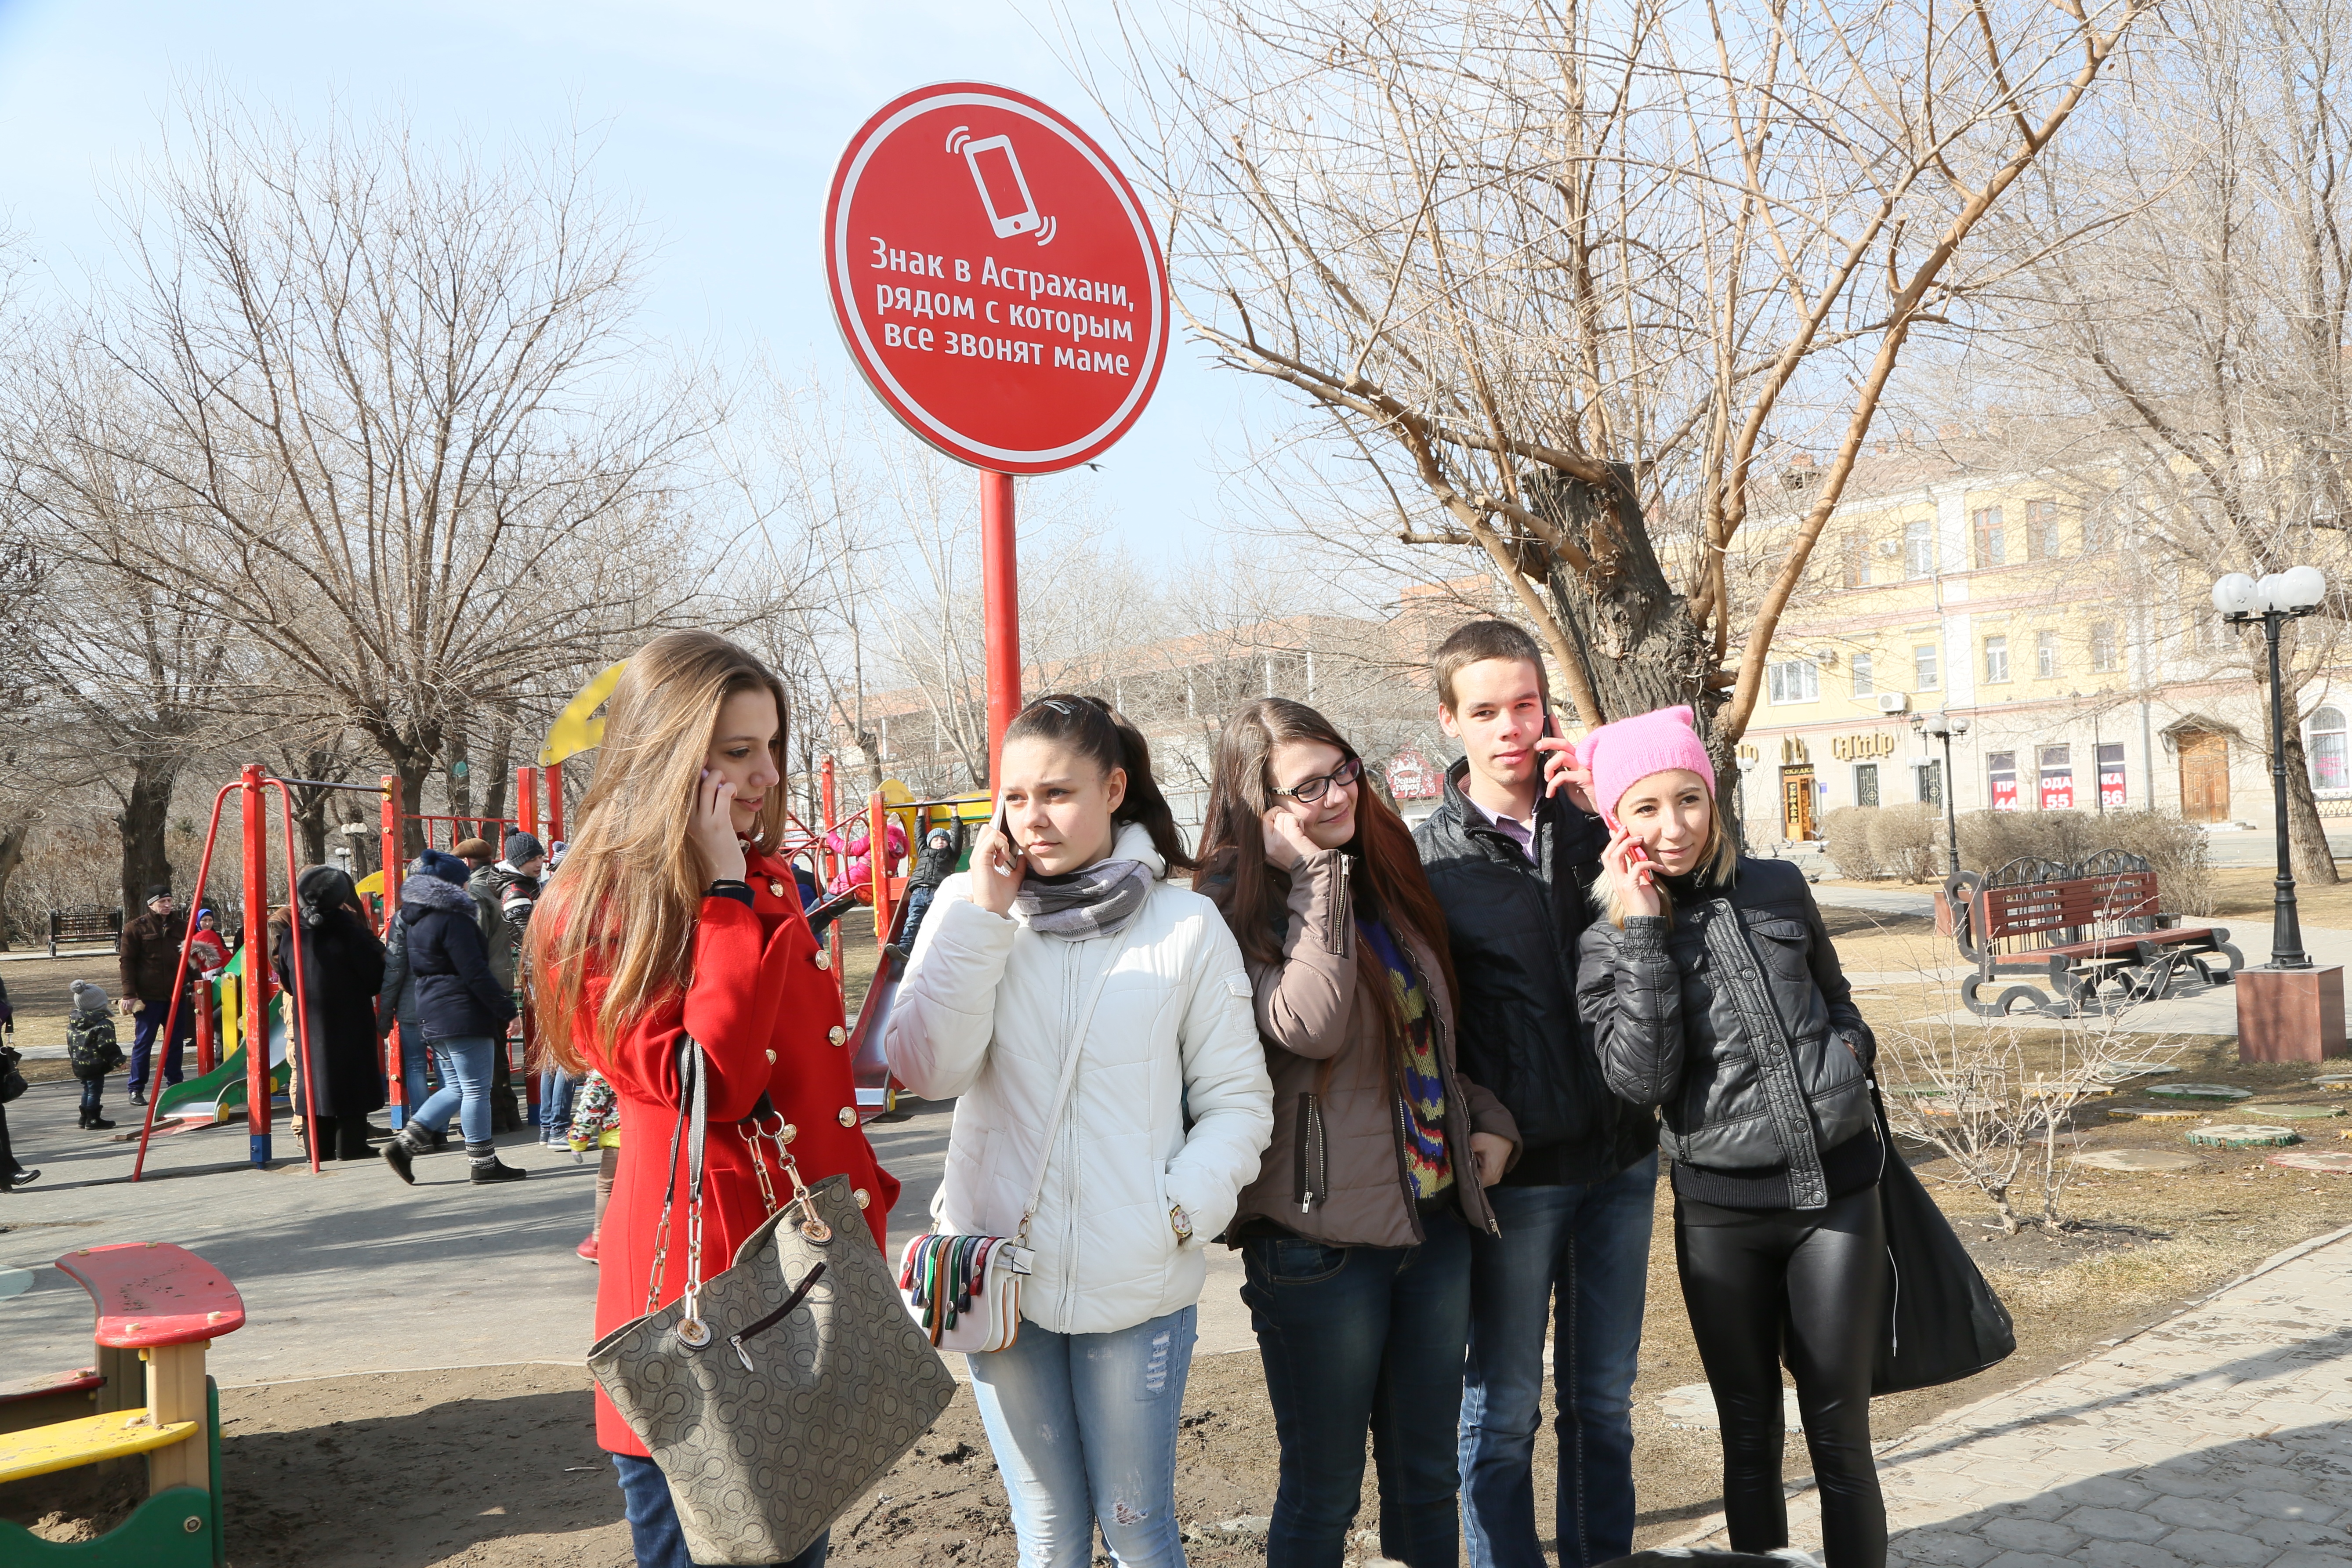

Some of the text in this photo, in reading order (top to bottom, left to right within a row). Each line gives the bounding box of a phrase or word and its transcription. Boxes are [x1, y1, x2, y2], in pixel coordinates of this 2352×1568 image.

[870, 236, 1134, 312] Знак в Астрахани,
[877, 284, 1133, 342] рядом с которым
[884, 323, 1129, 376] все звонят маме
[1789, 783, 1798, 823] СКИДКИ
[1995, 790, 2123, 811] 44 55 66
[1997, 772, 2123, 792] ПР ОДА ЖА
